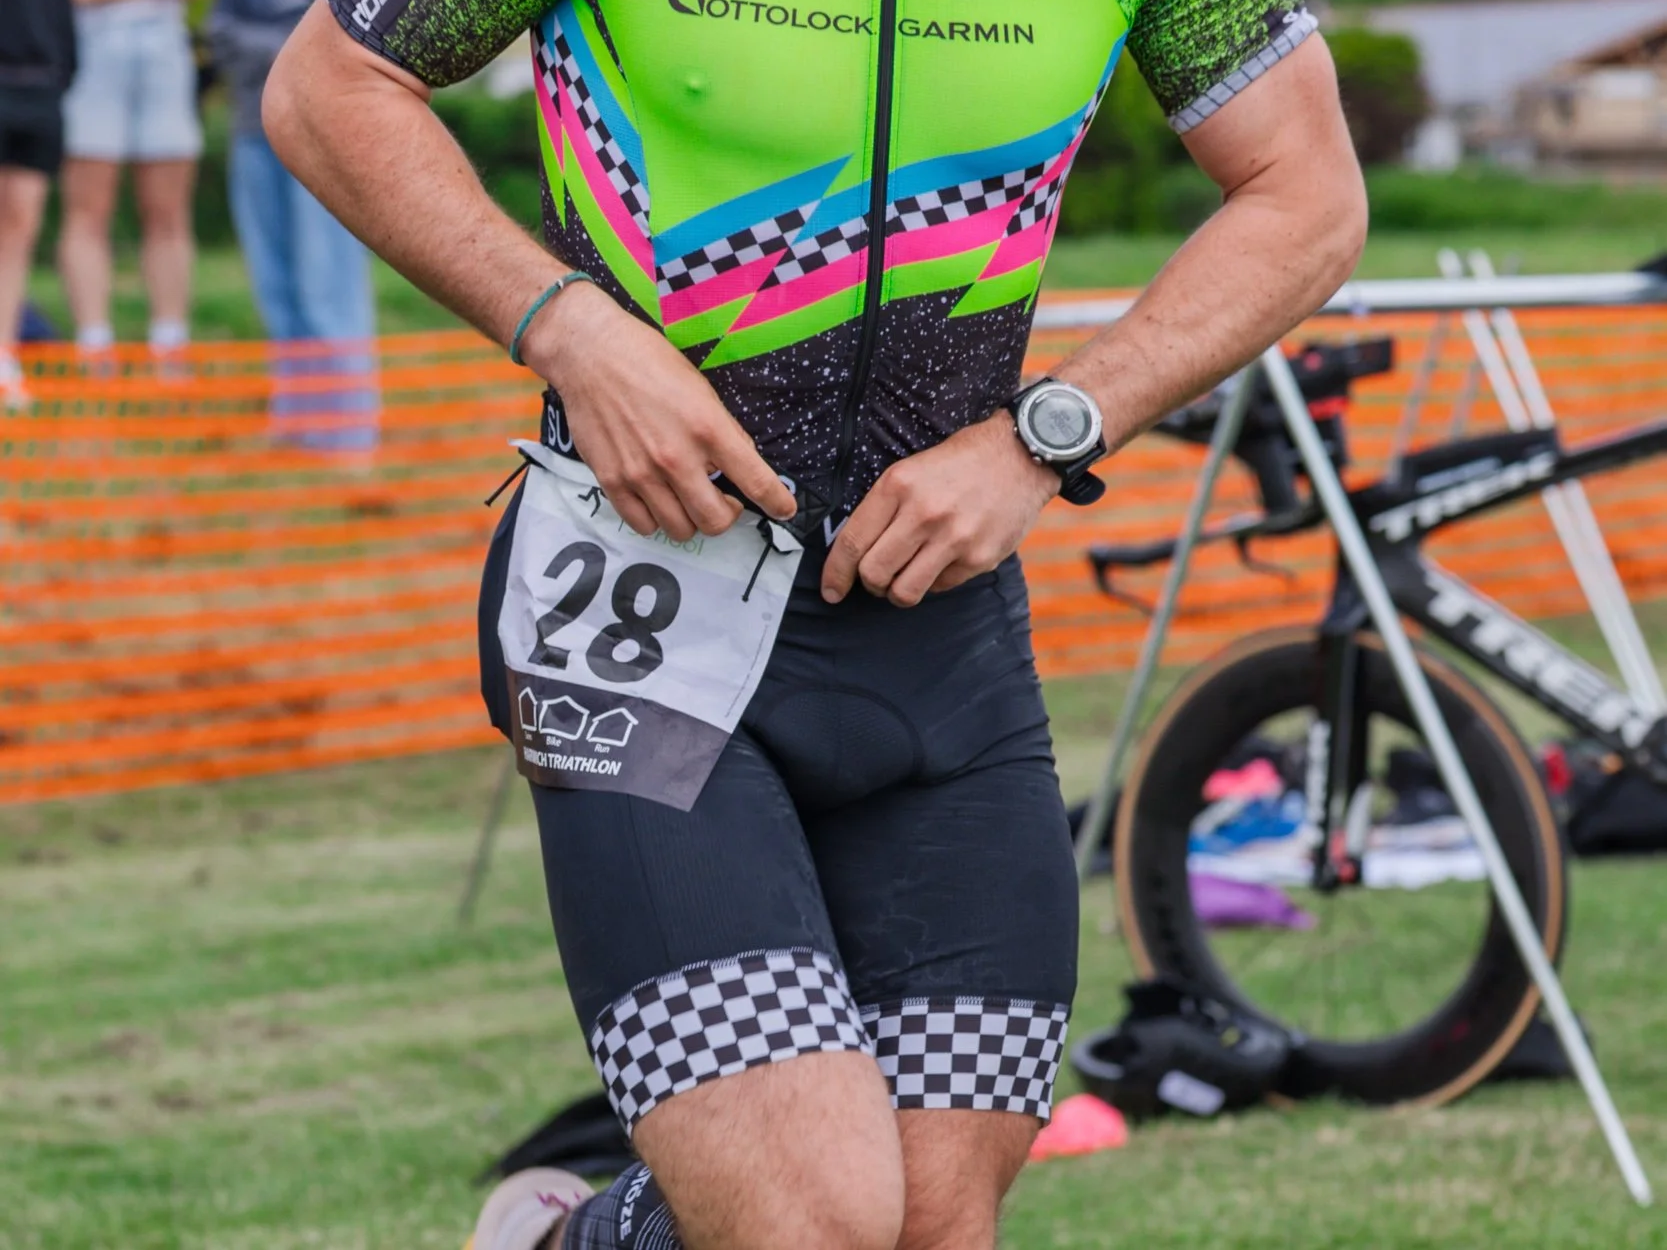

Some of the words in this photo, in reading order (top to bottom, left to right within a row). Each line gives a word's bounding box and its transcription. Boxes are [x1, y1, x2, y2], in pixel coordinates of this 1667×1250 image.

[897, 20, 1034, 44] GARMIN
[527, 540, 682, 684] 28
[1425, 567, 1652, 748] TREK
[545, 735, 562, 747] Bike
[593, 743, 610, 754] Run
[547, 753, 622, 776] TRIATHLON
